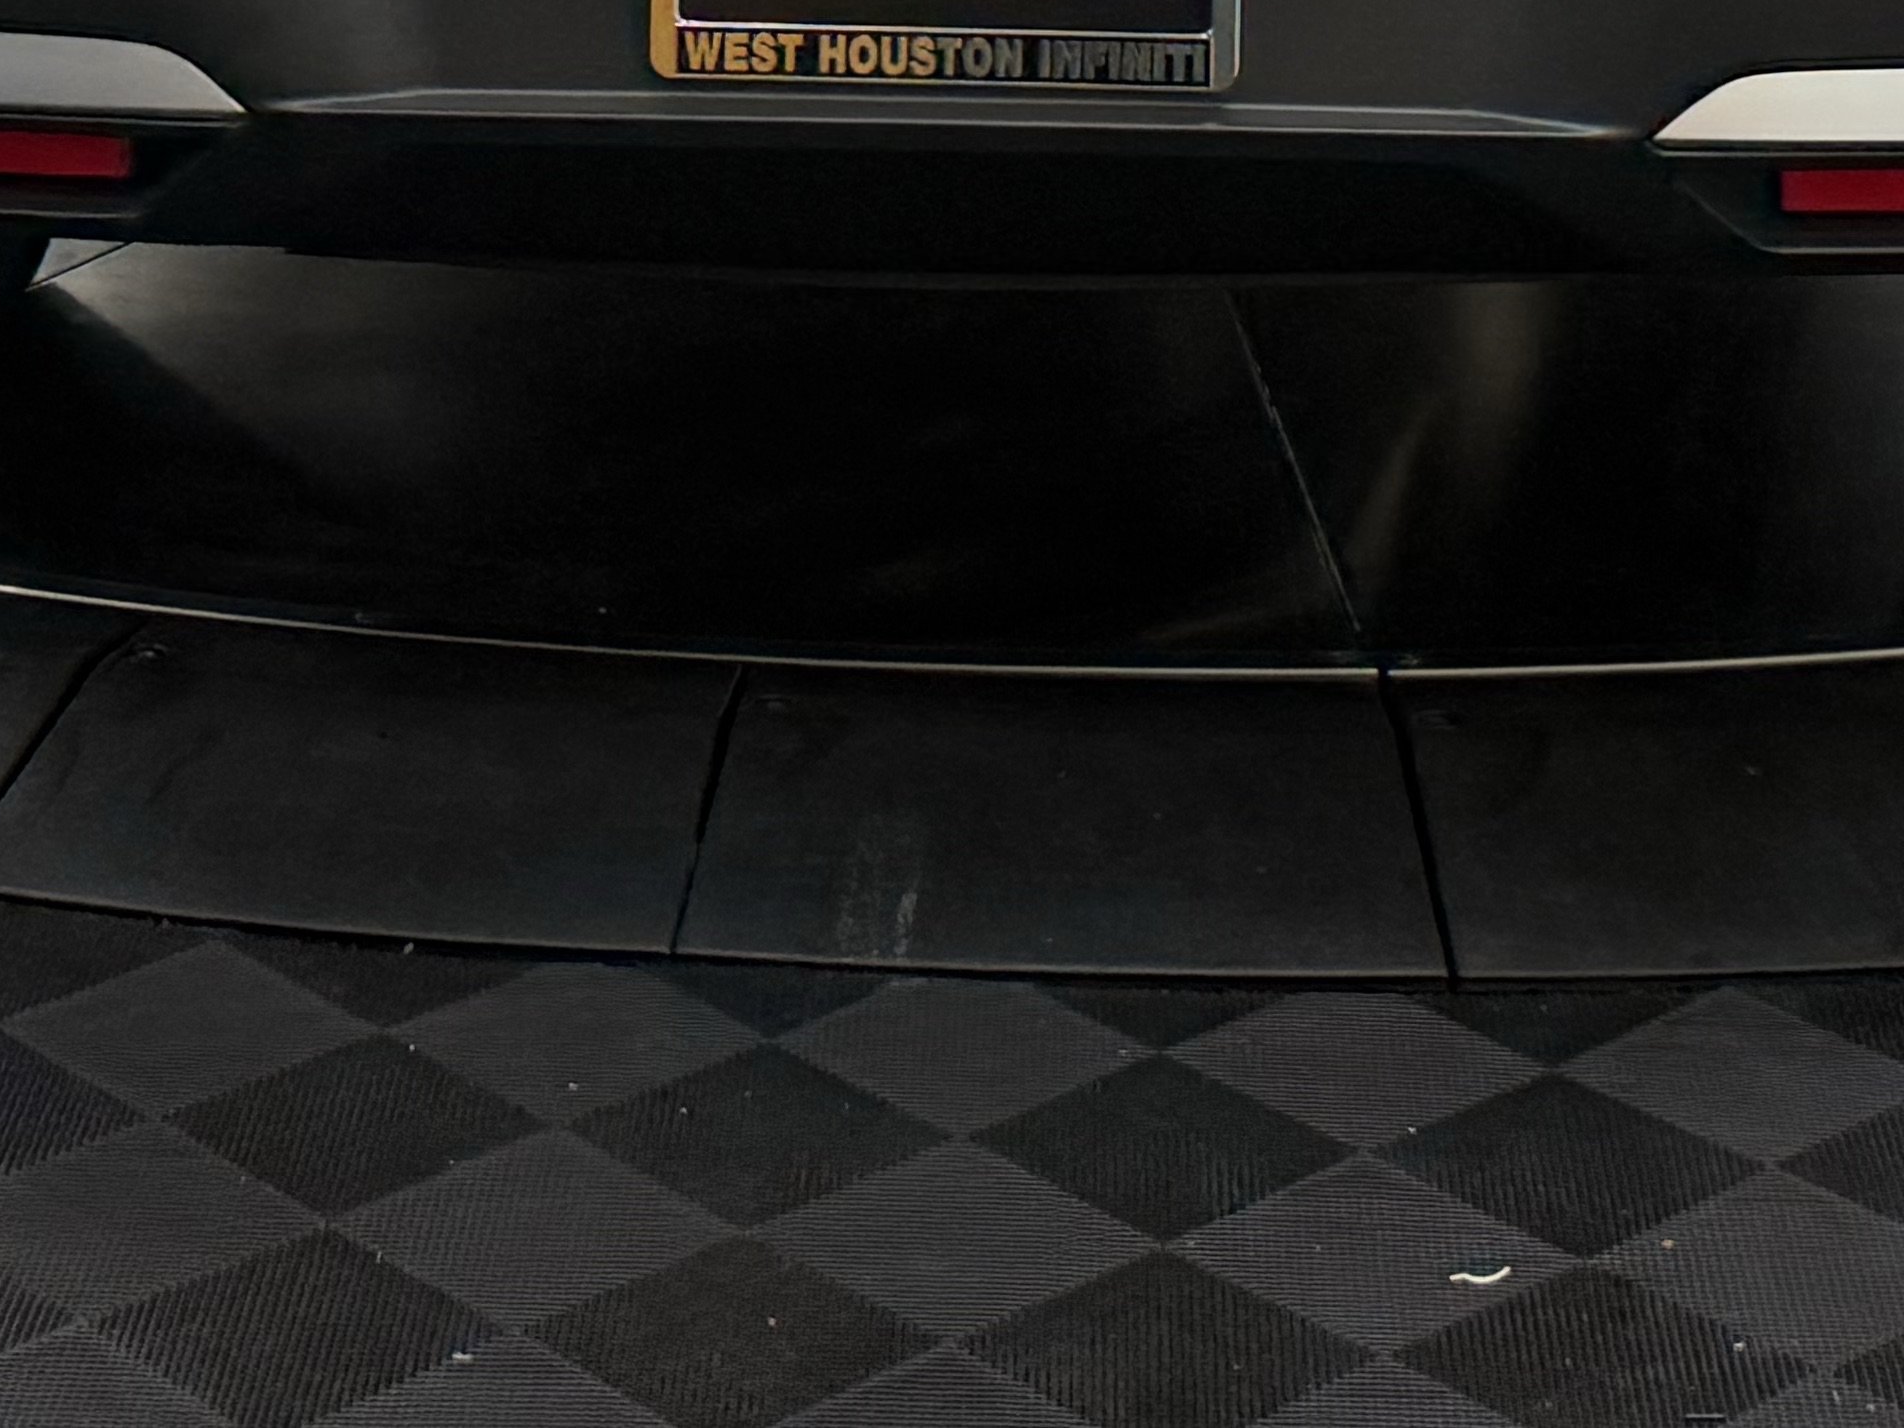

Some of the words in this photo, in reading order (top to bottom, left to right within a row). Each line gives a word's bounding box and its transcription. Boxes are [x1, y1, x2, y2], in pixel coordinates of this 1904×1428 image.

[684, 30, 805, 74] WEST
[819, 33, 1026, 79] HOUSTON
[1038, 38, 1207, 84] INFINITI
